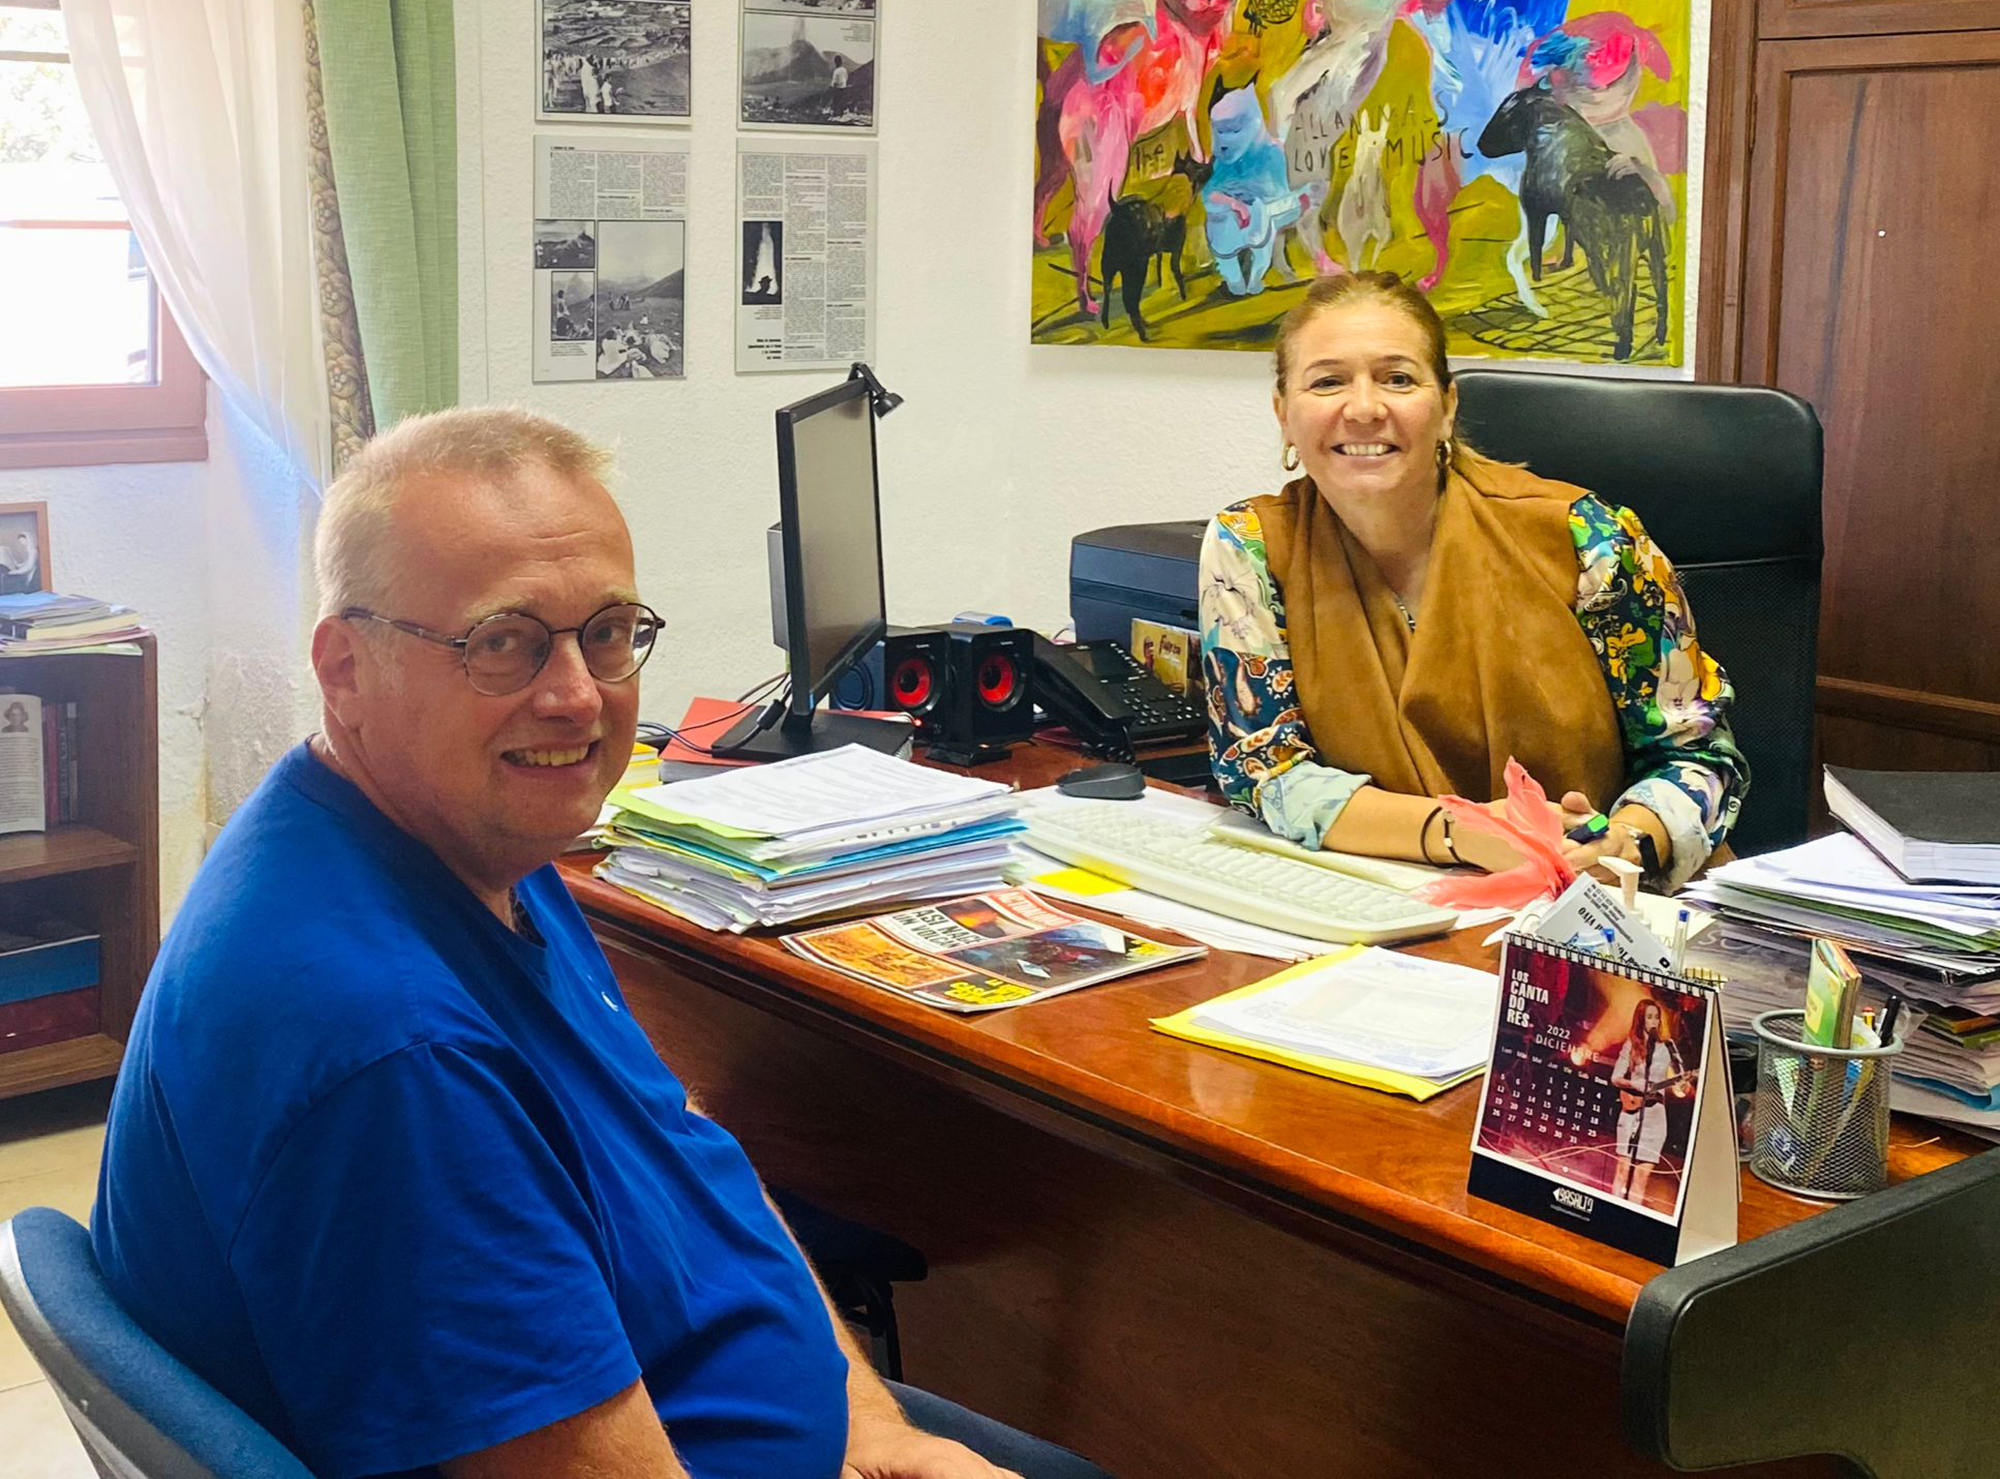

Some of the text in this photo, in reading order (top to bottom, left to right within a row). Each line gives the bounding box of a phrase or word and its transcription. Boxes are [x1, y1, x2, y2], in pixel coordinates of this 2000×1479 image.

[1294, 127, 1474, 173] LOVE MUSIC
[1512, 969, 1529, 983] LOS
[1510, 980, 1549, 1005] CANTA
[1508, 994, 1526, 1012] DO
[1546, 1024, 1571, 1040] 2022
[1531, 1083, 1537, 1091] 7
[1563, 1081, 1569, 1090] 2
[1579, 1086, 1585, 1095] 3
[1596, 1092, 1602, 1100] 4
[1527, 1095, 1536, 1104] 14
[1574, 1111, 1583, 1120] 17
[1507, 1113, 1517, 1123] 27
[1540, 1112, 1550, 1121] 22
[1571, 1123, 1581, 1132] 24
